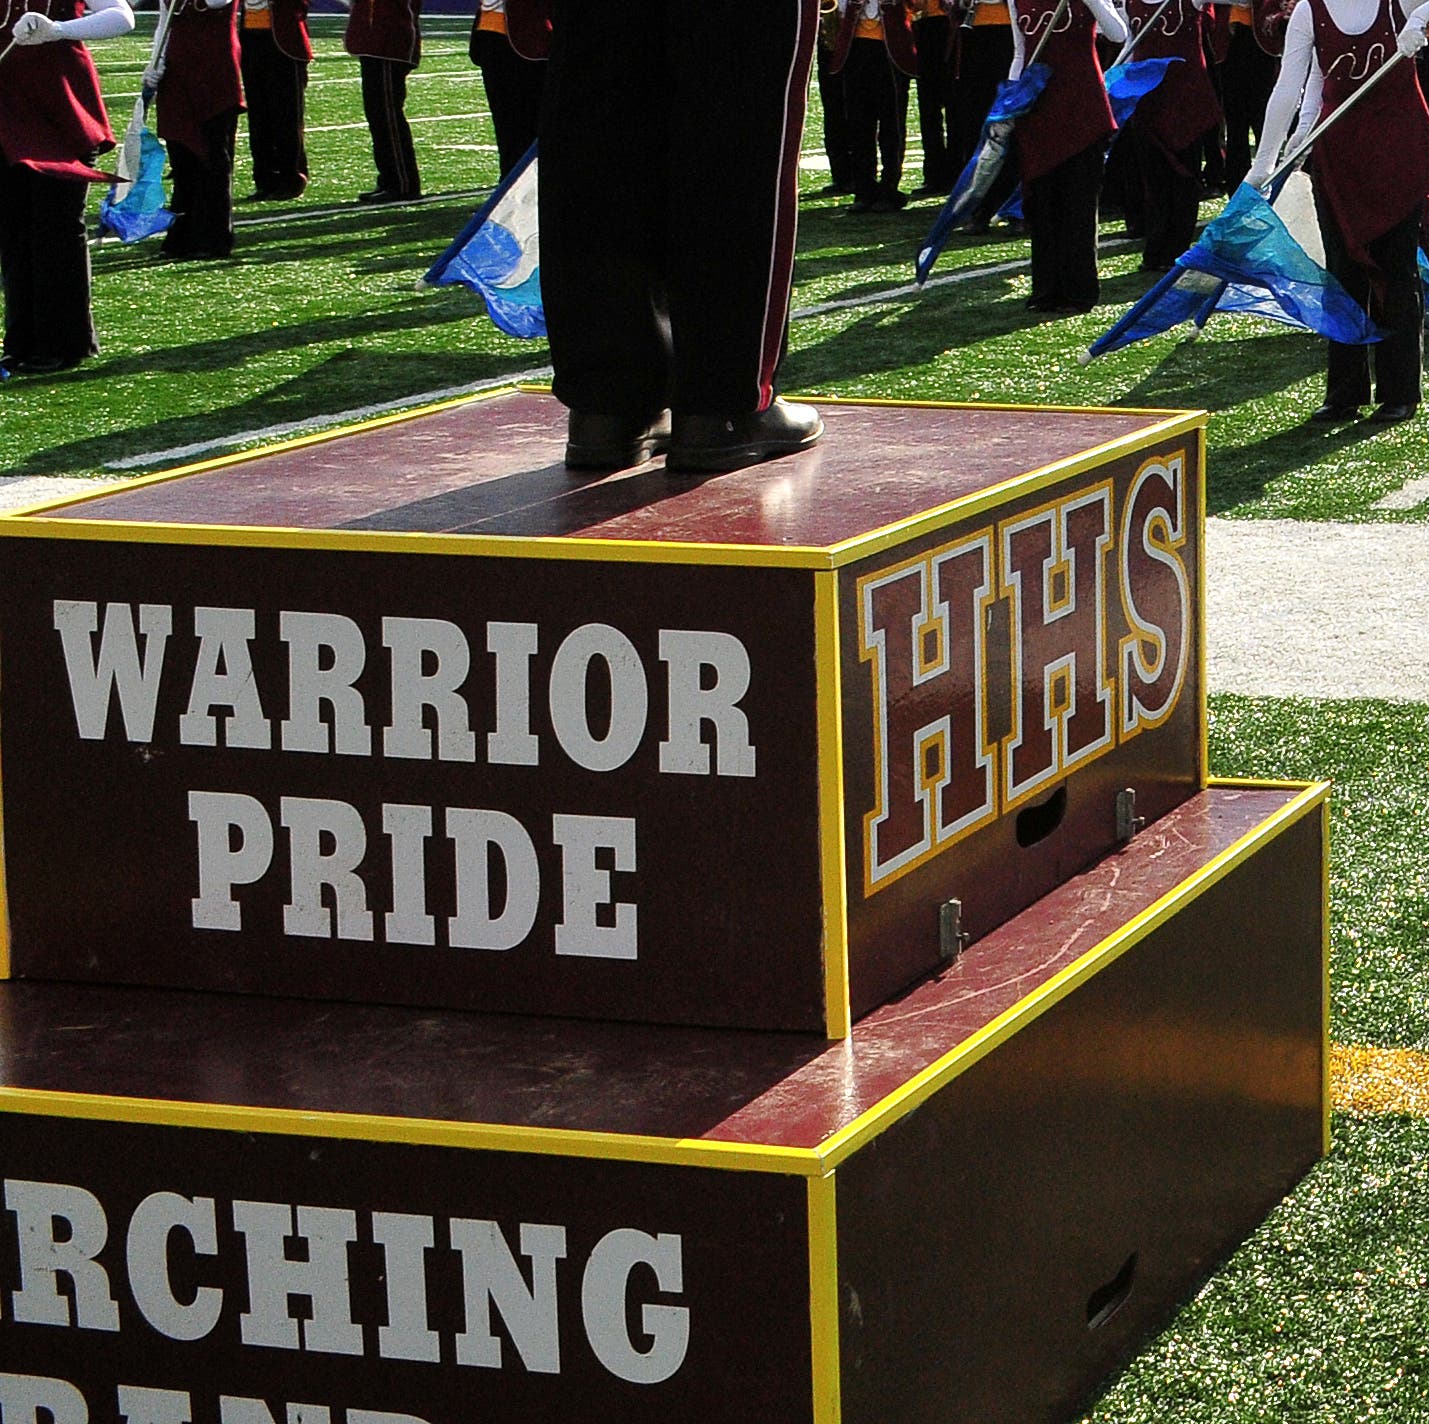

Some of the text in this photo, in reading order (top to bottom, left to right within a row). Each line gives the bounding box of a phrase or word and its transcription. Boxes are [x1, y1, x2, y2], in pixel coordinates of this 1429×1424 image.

[54, 599, 756, 777] WARRIOR
[856, 449, 1191, 899] HHS
[188, 791, 638, 959] PRIDE
[4, 1179, 690, 1384] RCHING
